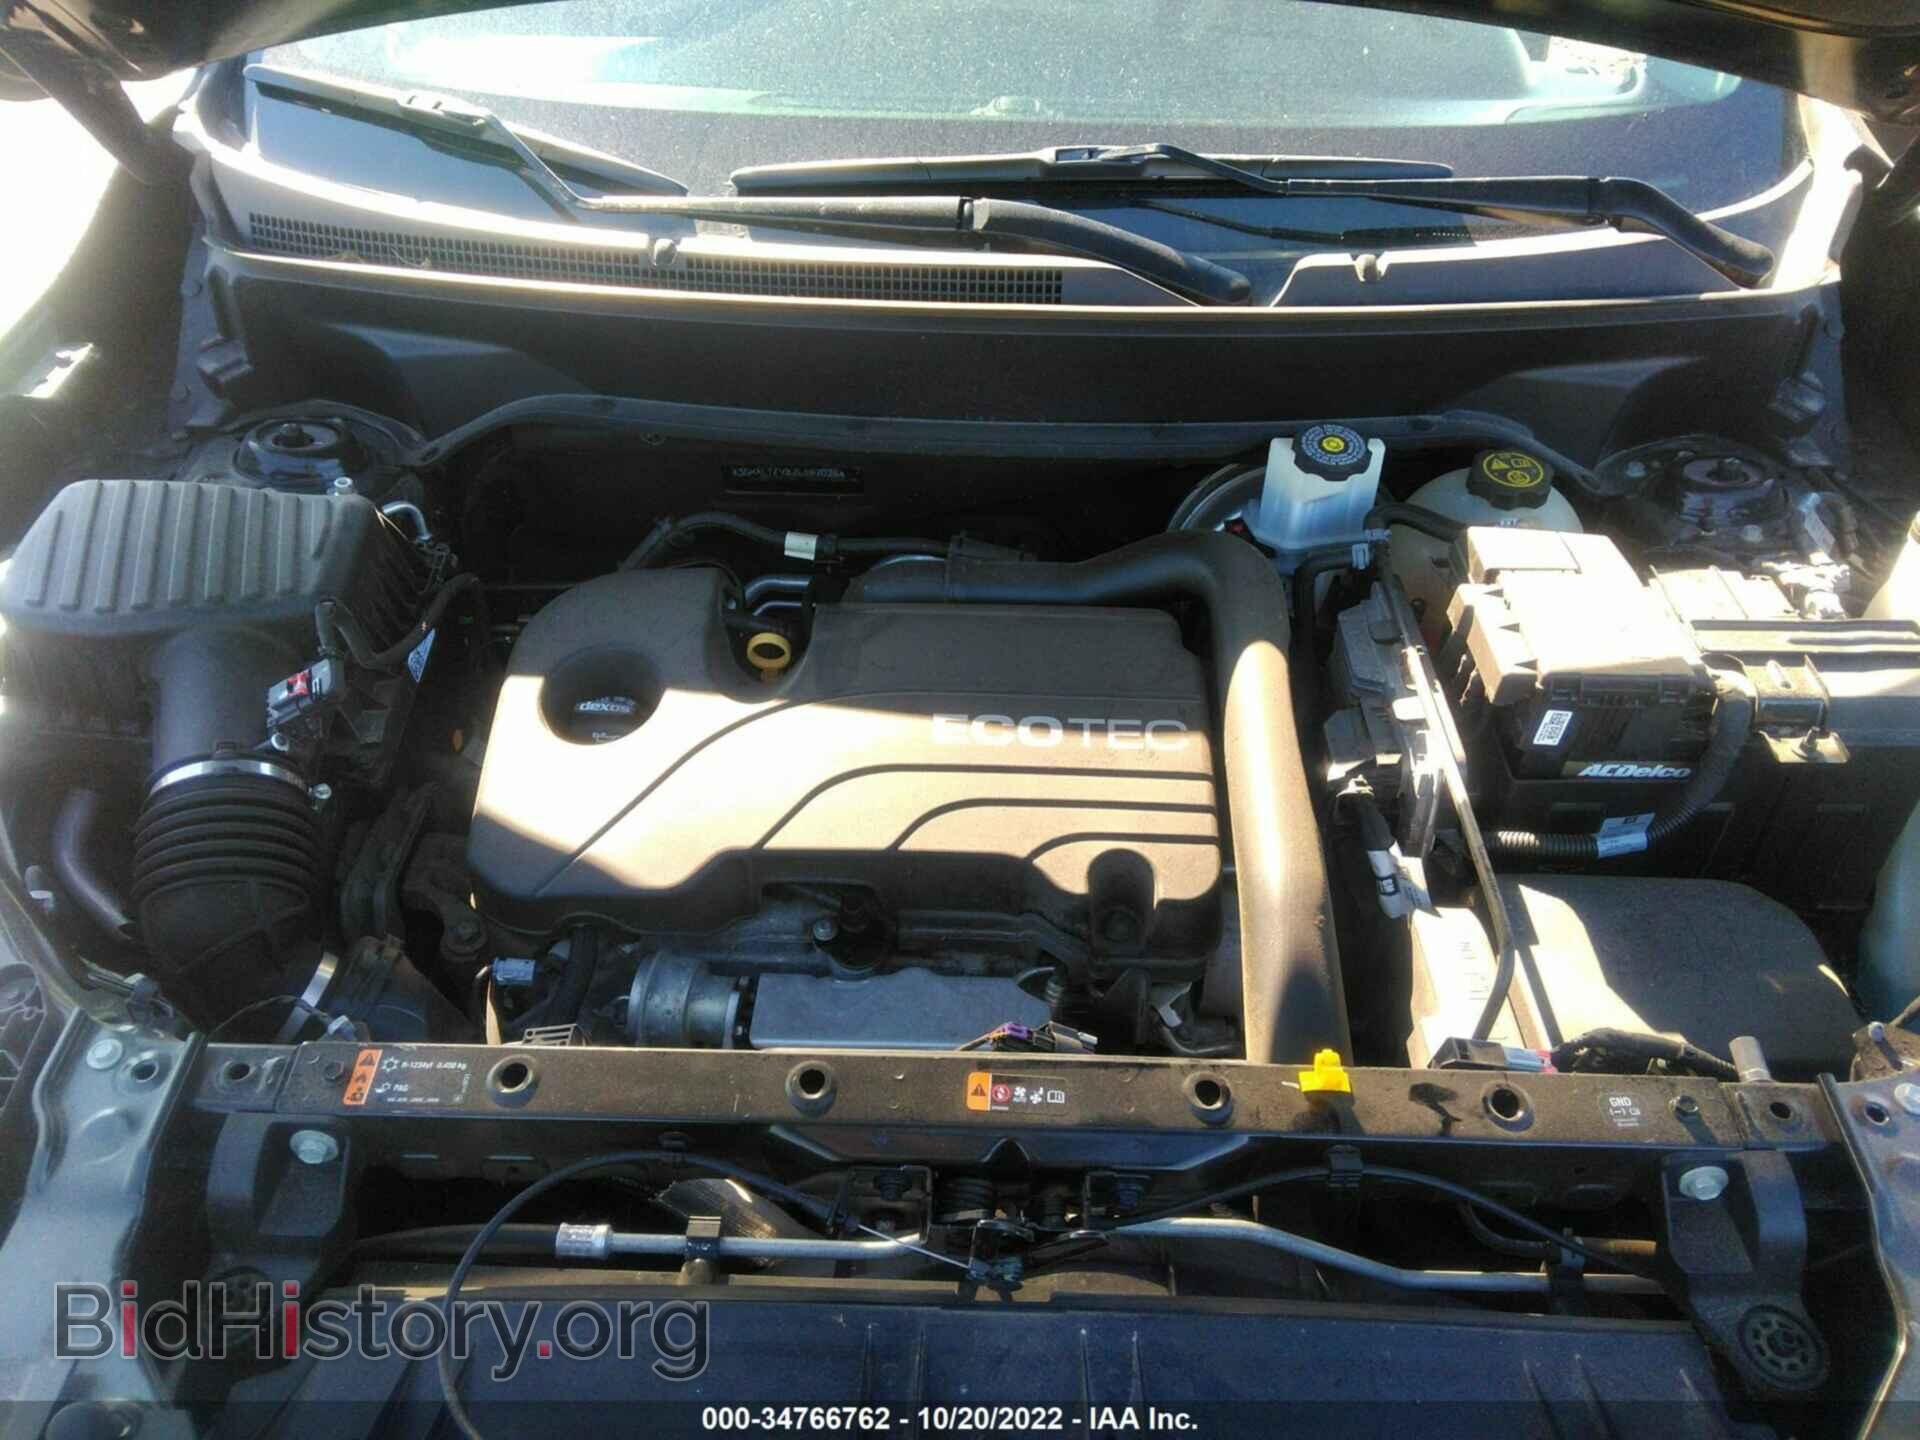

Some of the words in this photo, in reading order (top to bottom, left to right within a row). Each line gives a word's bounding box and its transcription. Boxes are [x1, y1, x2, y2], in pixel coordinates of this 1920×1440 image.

[579, 700, 631, 713] dexos
[932, 713, 1189, 751] ECOTEC
[1577, 763, 1692, 779] ACDelco
[1609, 1096, 1632, 1107] GND
